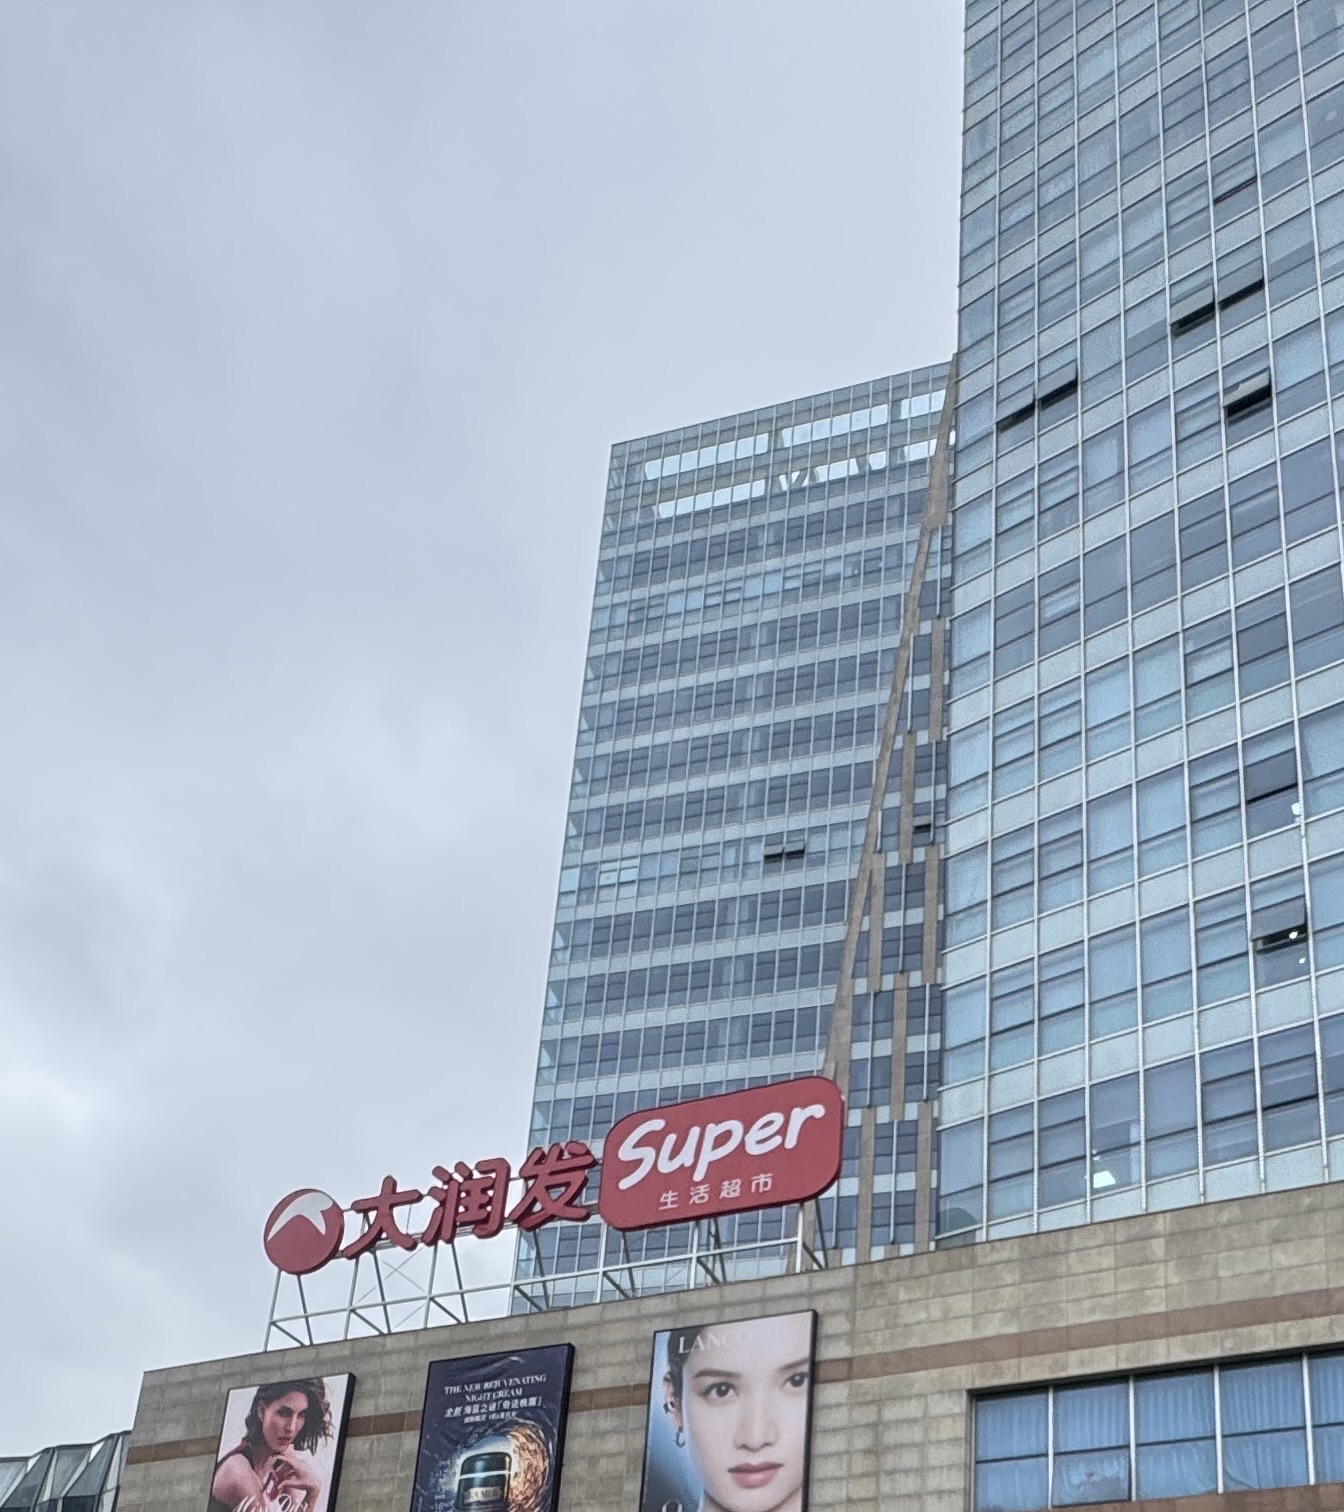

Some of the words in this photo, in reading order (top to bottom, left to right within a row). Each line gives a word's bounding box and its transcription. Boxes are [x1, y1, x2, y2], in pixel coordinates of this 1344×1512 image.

[617, 1104, 826, 1191] Super
[343, 1141, 598, 1259] 大润发
[659, 1172, 773, 1211] 生活超市
